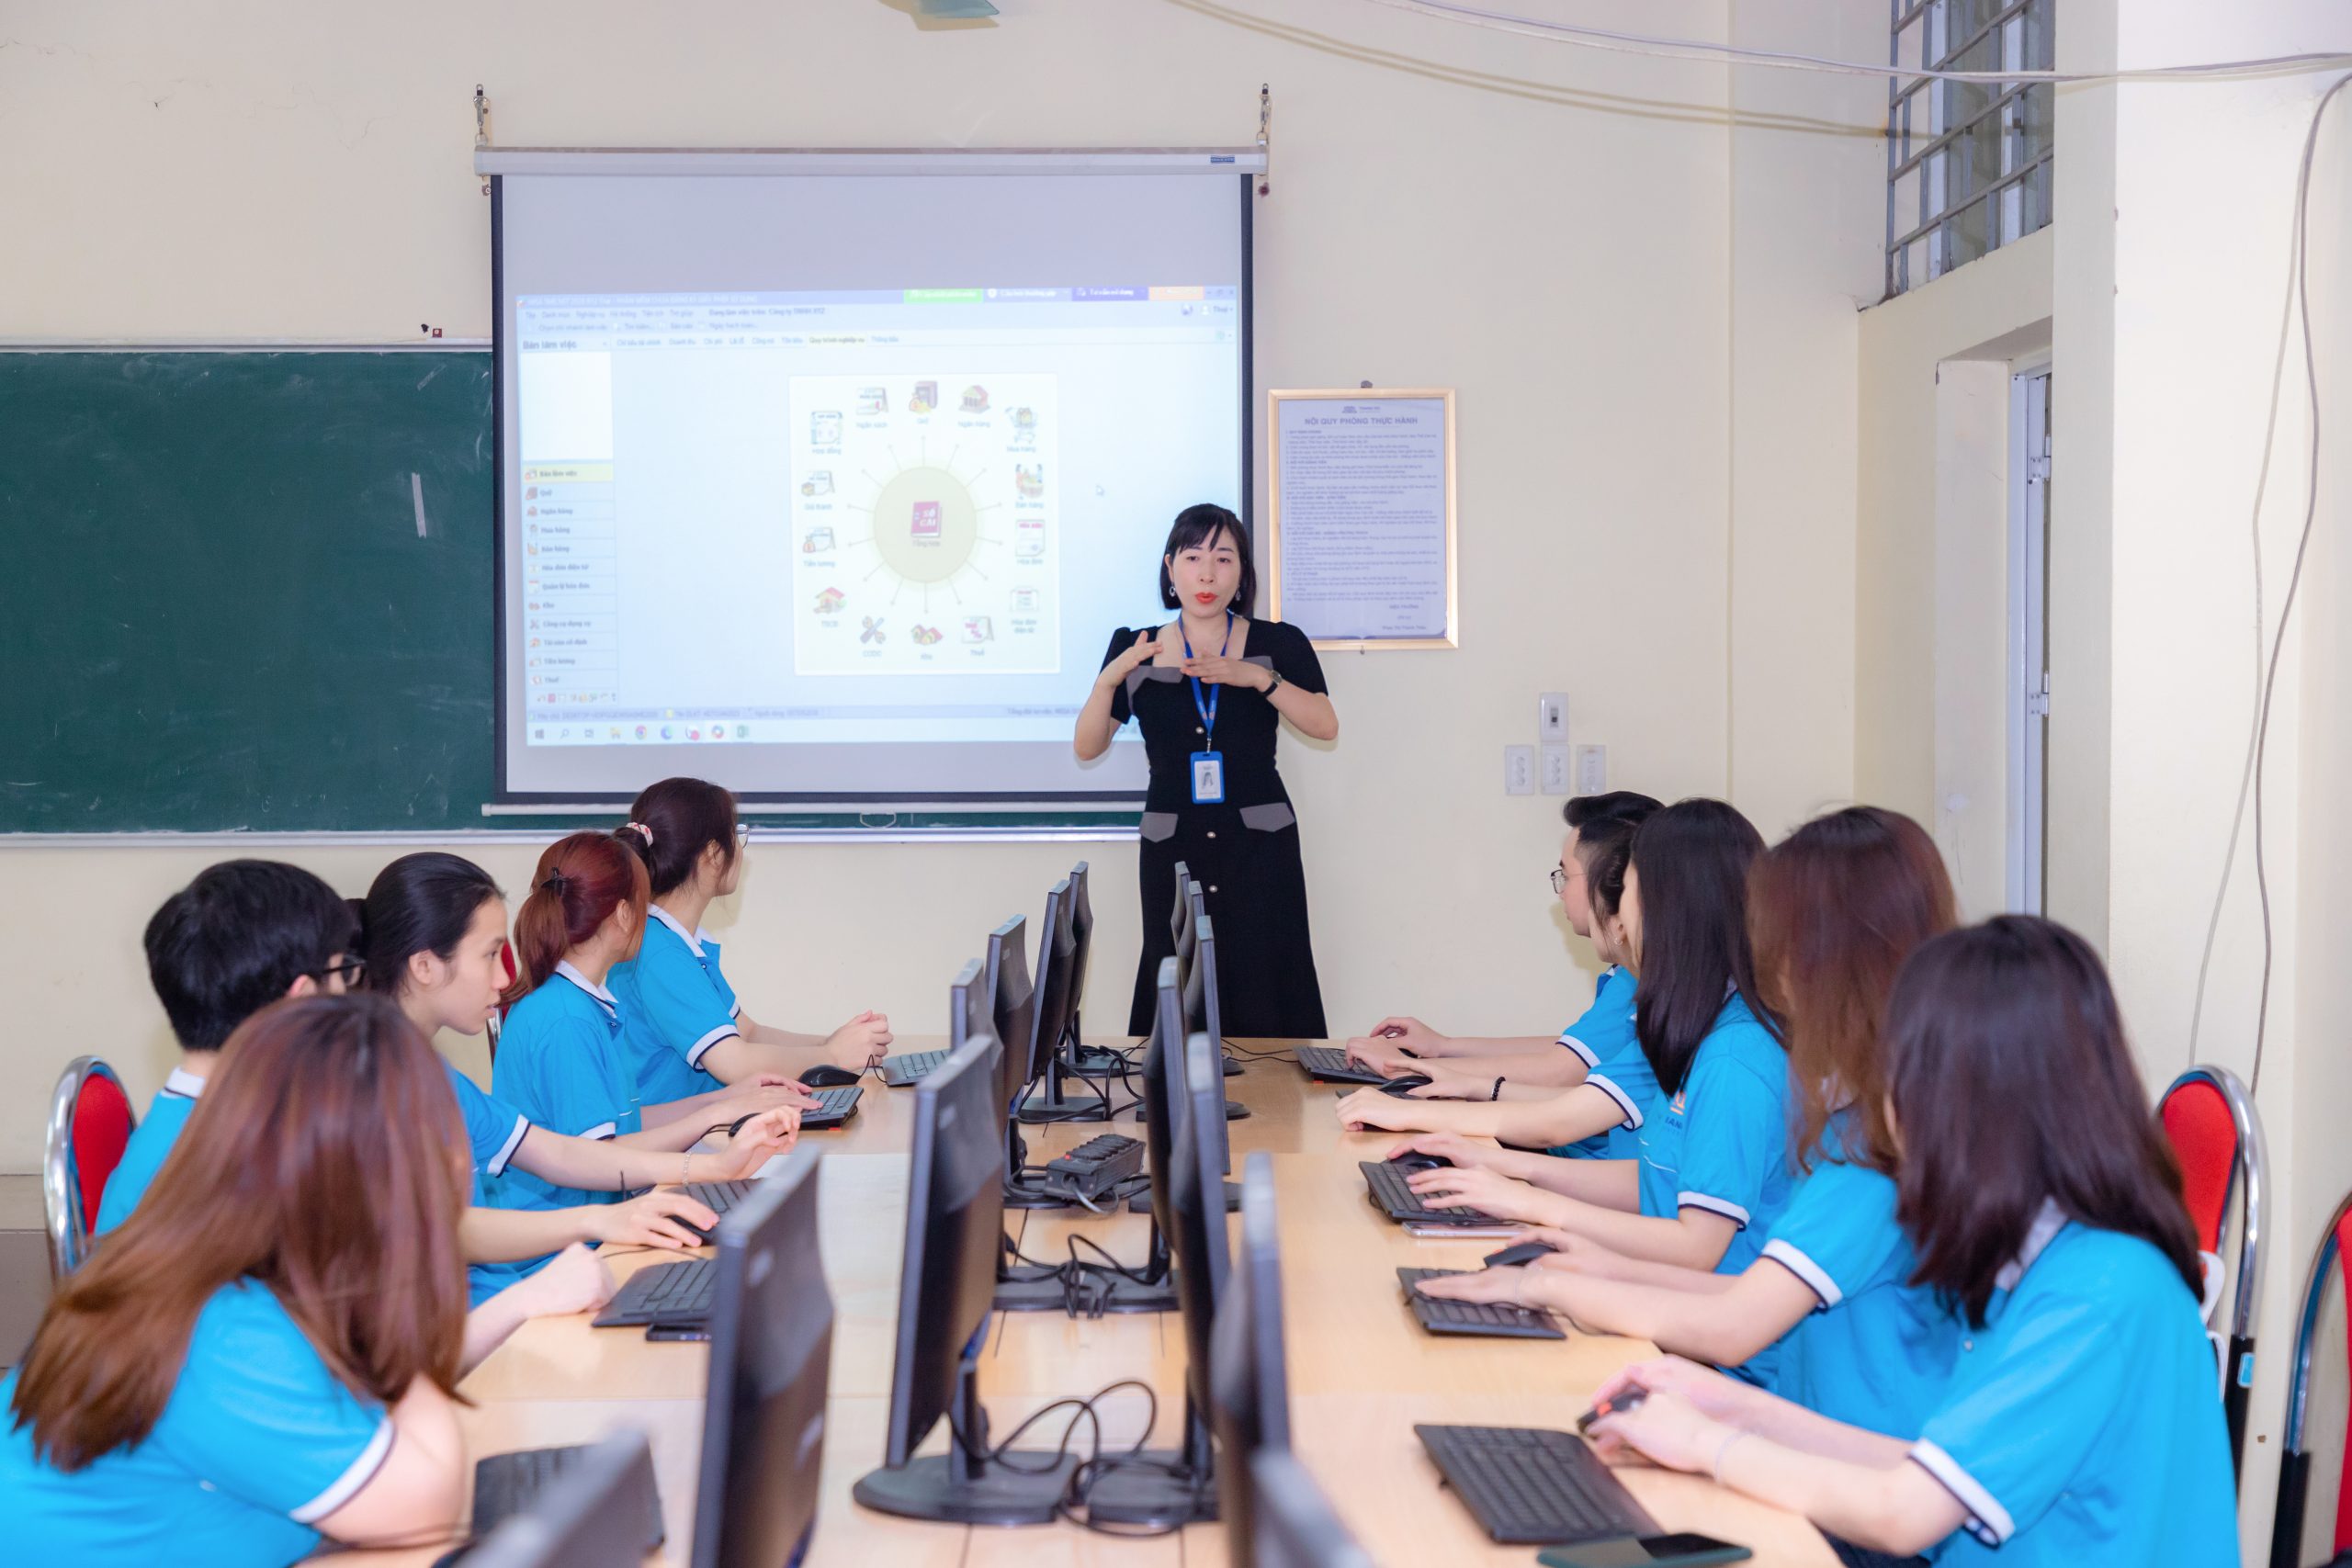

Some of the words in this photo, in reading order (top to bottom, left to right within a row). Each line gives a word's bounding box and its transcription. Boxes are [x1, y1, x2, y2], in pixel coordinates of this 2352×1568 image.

[1320, 417, 1339, 425] QUY
[1340, 416, 1369, 425] PHÒNG
[1395, 416, 1419, 425] HÀNH
